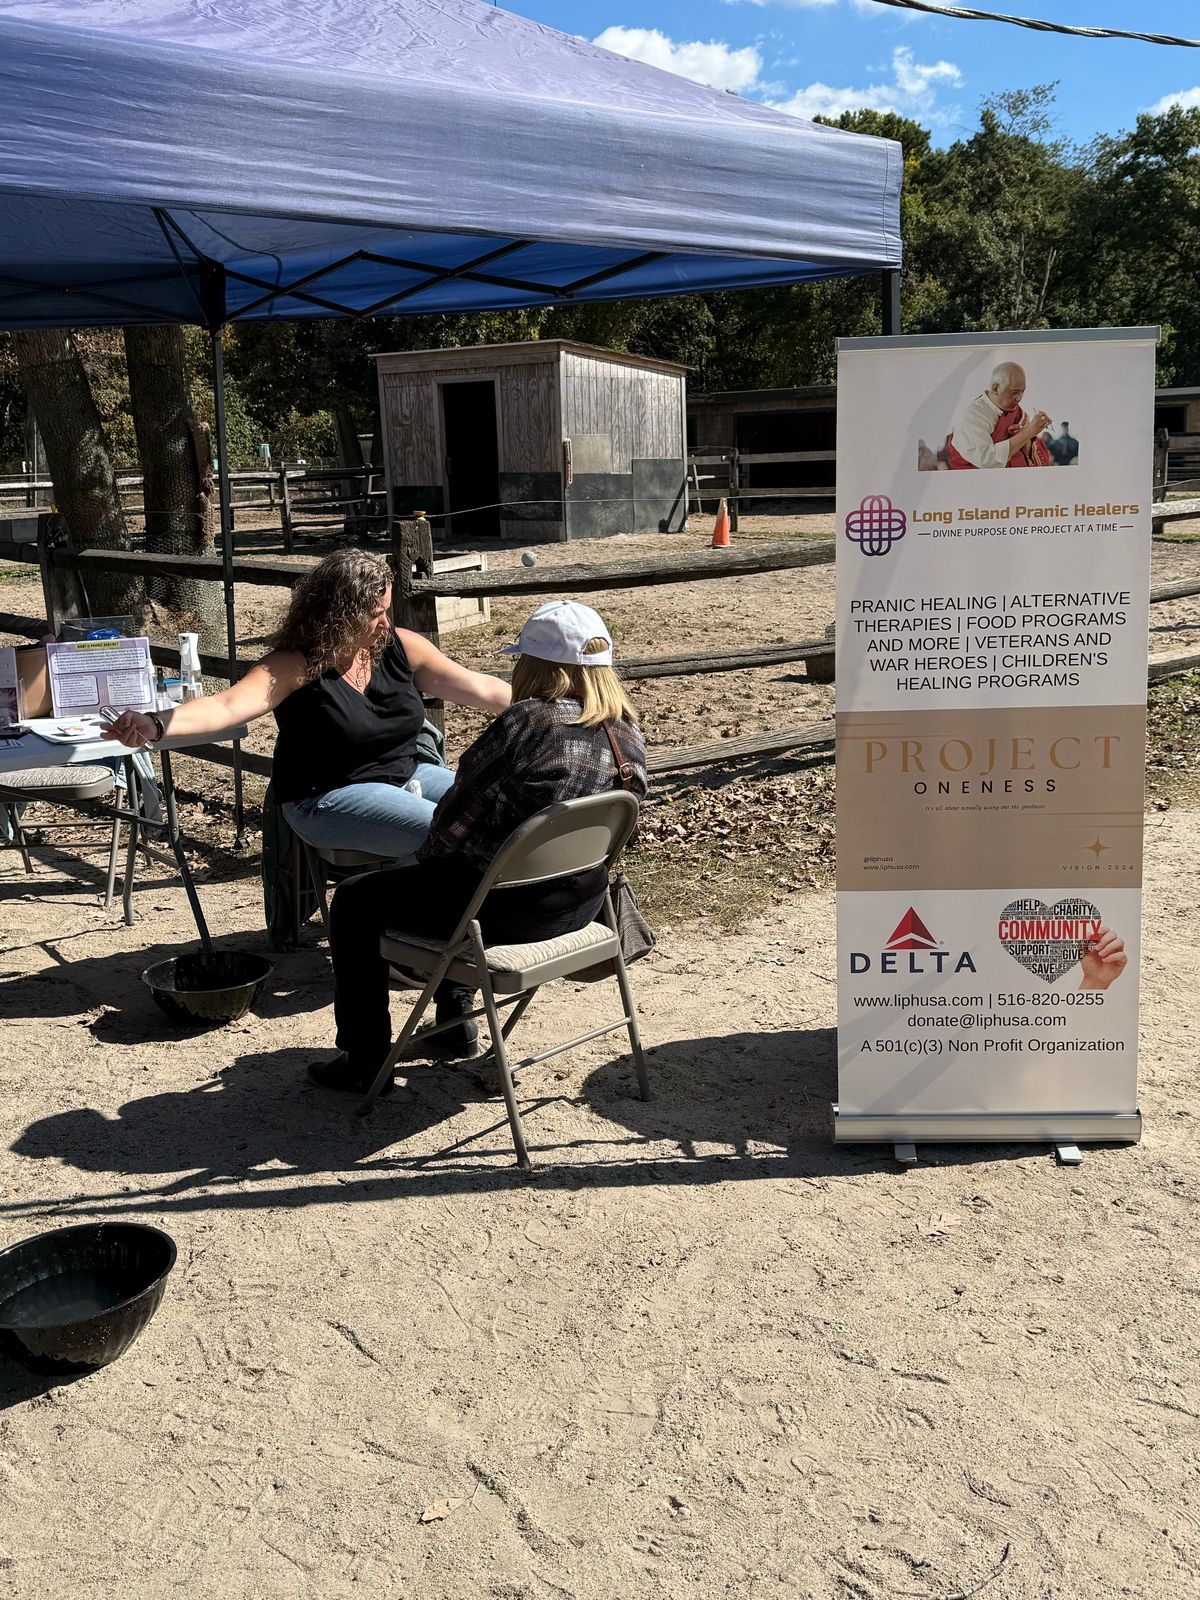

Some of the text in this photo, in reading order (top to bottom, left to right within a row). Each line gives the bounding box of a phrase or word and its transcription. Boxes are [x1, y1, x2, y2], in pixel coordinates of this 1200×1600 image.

[912, 502, 1140, 524] Long Island Pranic Healers
[932, 523, 1118, 538] DIVINE PURPOSE ONE PROJECT AT A TIME
[850, 598, 916, 613] PRANIC
[921, 595, 997, 611] HEALING
[1010, 591, 1131, 609] ALTERNATIVE
[854, 616, 952, 633] THERAPIES
[967, 615, 1017, 630] FOOD
[1022, 611, 1127, 628] PROGRAMS
[867, 638, 903, 652] AND
[908, 636, 960, 651] MORE
[975, 633, 1070, 649] VETERANS
[1073, 632, 1112, 646] AND
[870, 658, 909, 672] WAR
[914, 655, 988, 671] HEROES
[1002, 652, 1108, 668] CHILDREN'S
[897, 672, 1080, 691] HEALING PROGRAMS
[864, 735, 1121, 776] PROJECT
[913, 779, 1057, 795] ONENESS
[1016, 899, 1041, 911] HELP
[1053, 904, 1094, 916] CHARITY
[998, 919, 1102, 940] COMMUNITY
[1009, 944, 1051, 956] SUPPORT
[1062, 948, 1083, 961] GIVE
[850, 951, 977, 974] DELTA
[1032, 963, 1055, 974] SAVE
[853, 993, 983, 1009] www.liphusa.com
[997, 992, 1105, 1007] 516-820-0255
[907, 1013, 1067, 1030] donate@liphusa.com
[861, 1038, 1125, 1056] A 501(c)(3) Non Profit Organization
